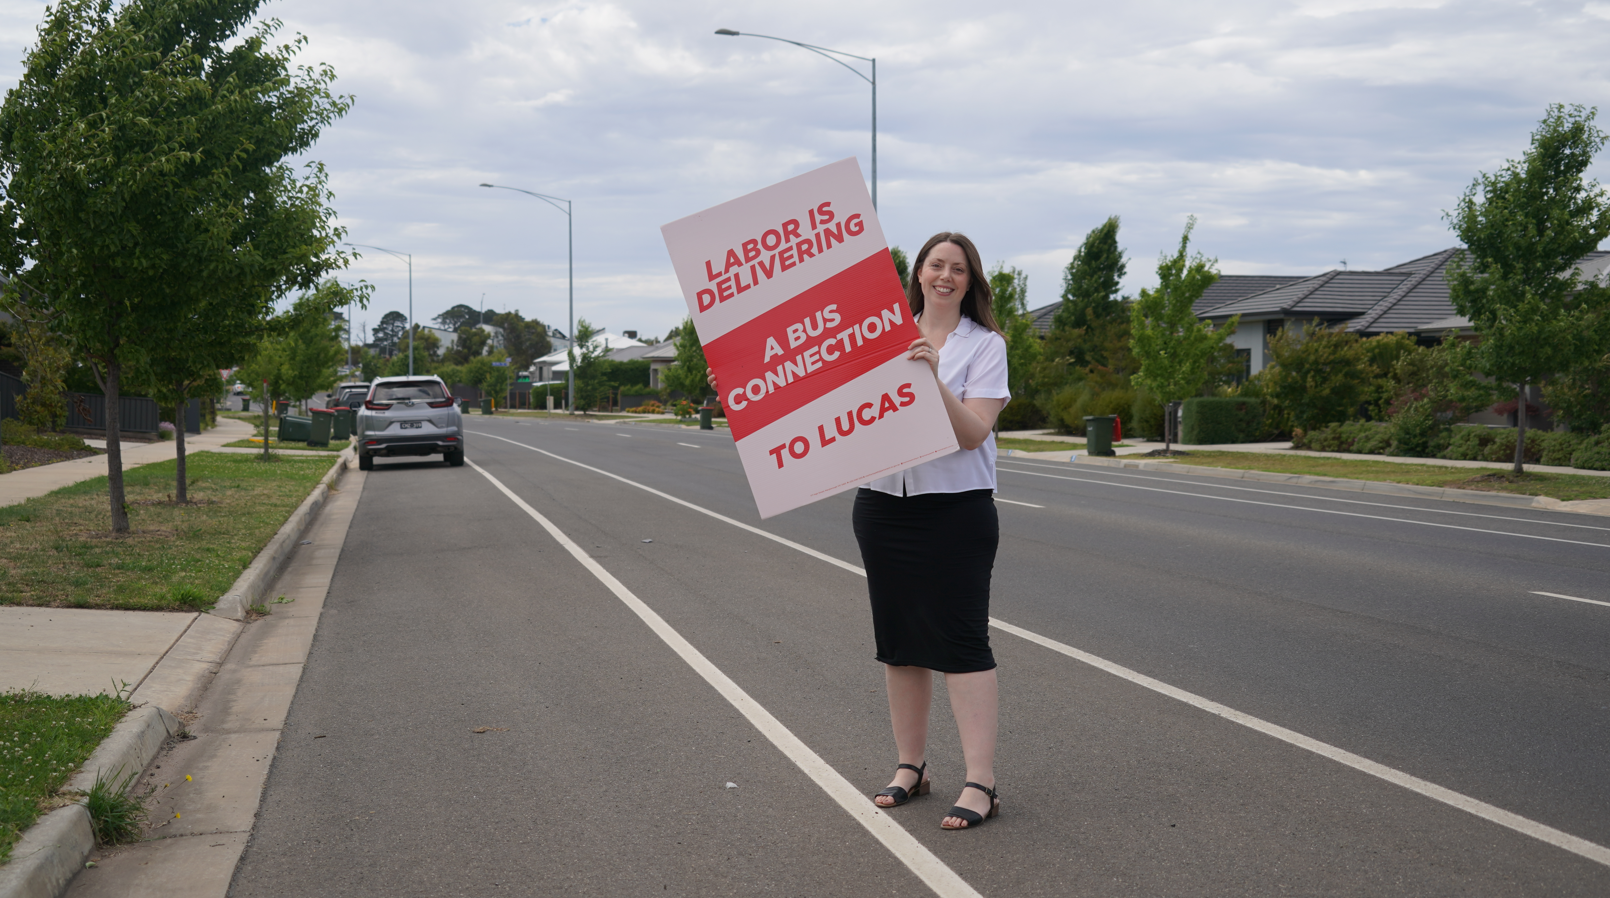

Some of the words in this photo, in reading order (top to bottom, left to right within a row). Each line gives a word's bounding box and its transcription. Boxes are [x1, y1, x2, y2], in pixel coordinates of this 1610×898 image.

[696, 213, 864, 313] DELIVERING
[705, 219, 802, 282] LABOR
[808, 202, 835, 230] IS
[728, 303, 904, 411] CONNECTION
[764, 336, 784, 363] A
[787, 303, 841, 349] BUS
[769, 436, 810, 469] TO
[818, 383, 915, 448] LUCAS
